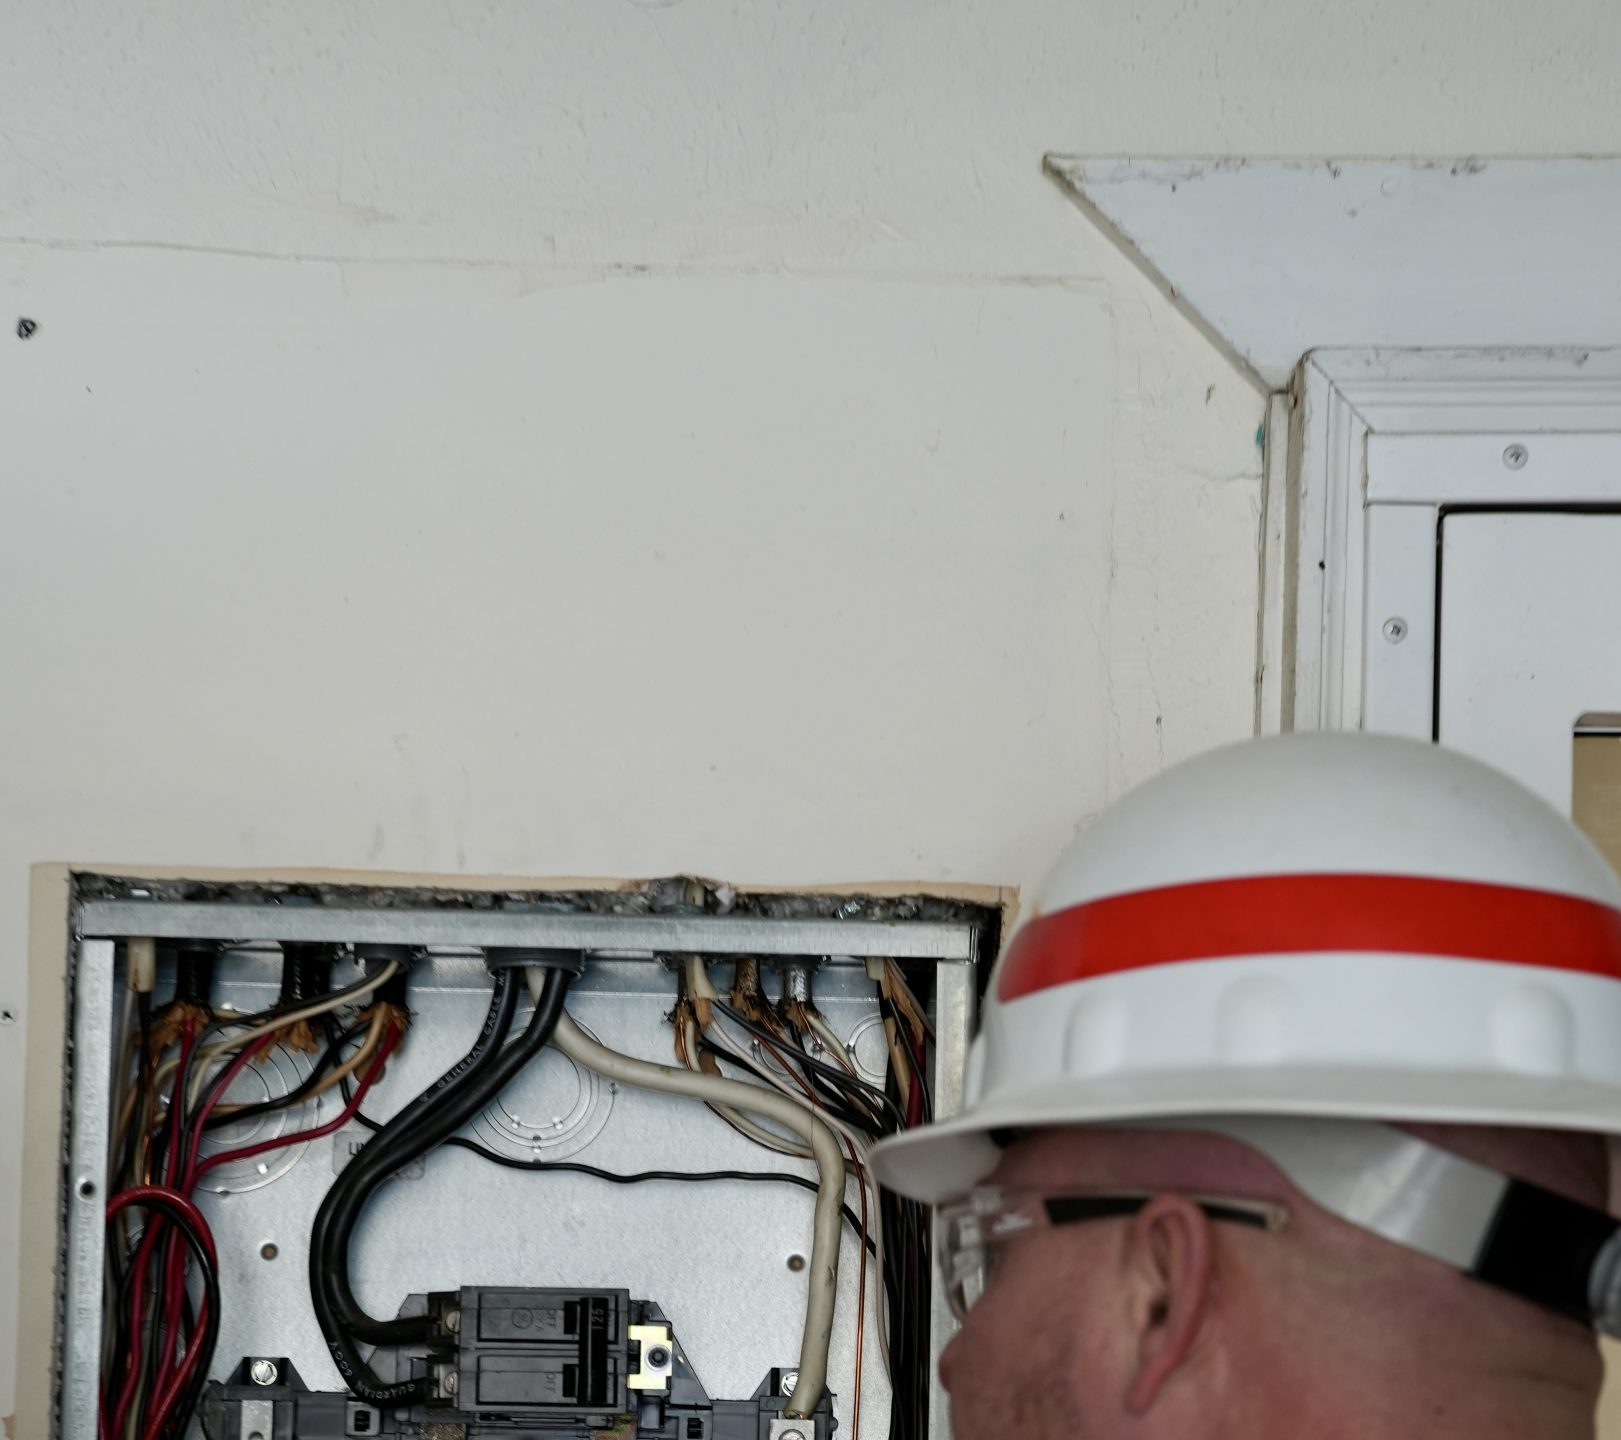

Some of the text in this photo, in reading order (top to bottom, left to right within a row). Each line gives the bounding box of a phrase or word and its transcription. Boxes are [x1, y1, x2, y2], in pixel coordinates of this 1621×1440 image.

[437, 995, 504, 1088] GENERAL CABLE
[546, 1308, 557, 1329] OFF
[355, 1380, 416, 1399] GUARDIAN
[546, 1373, 556, 1394] OFF
